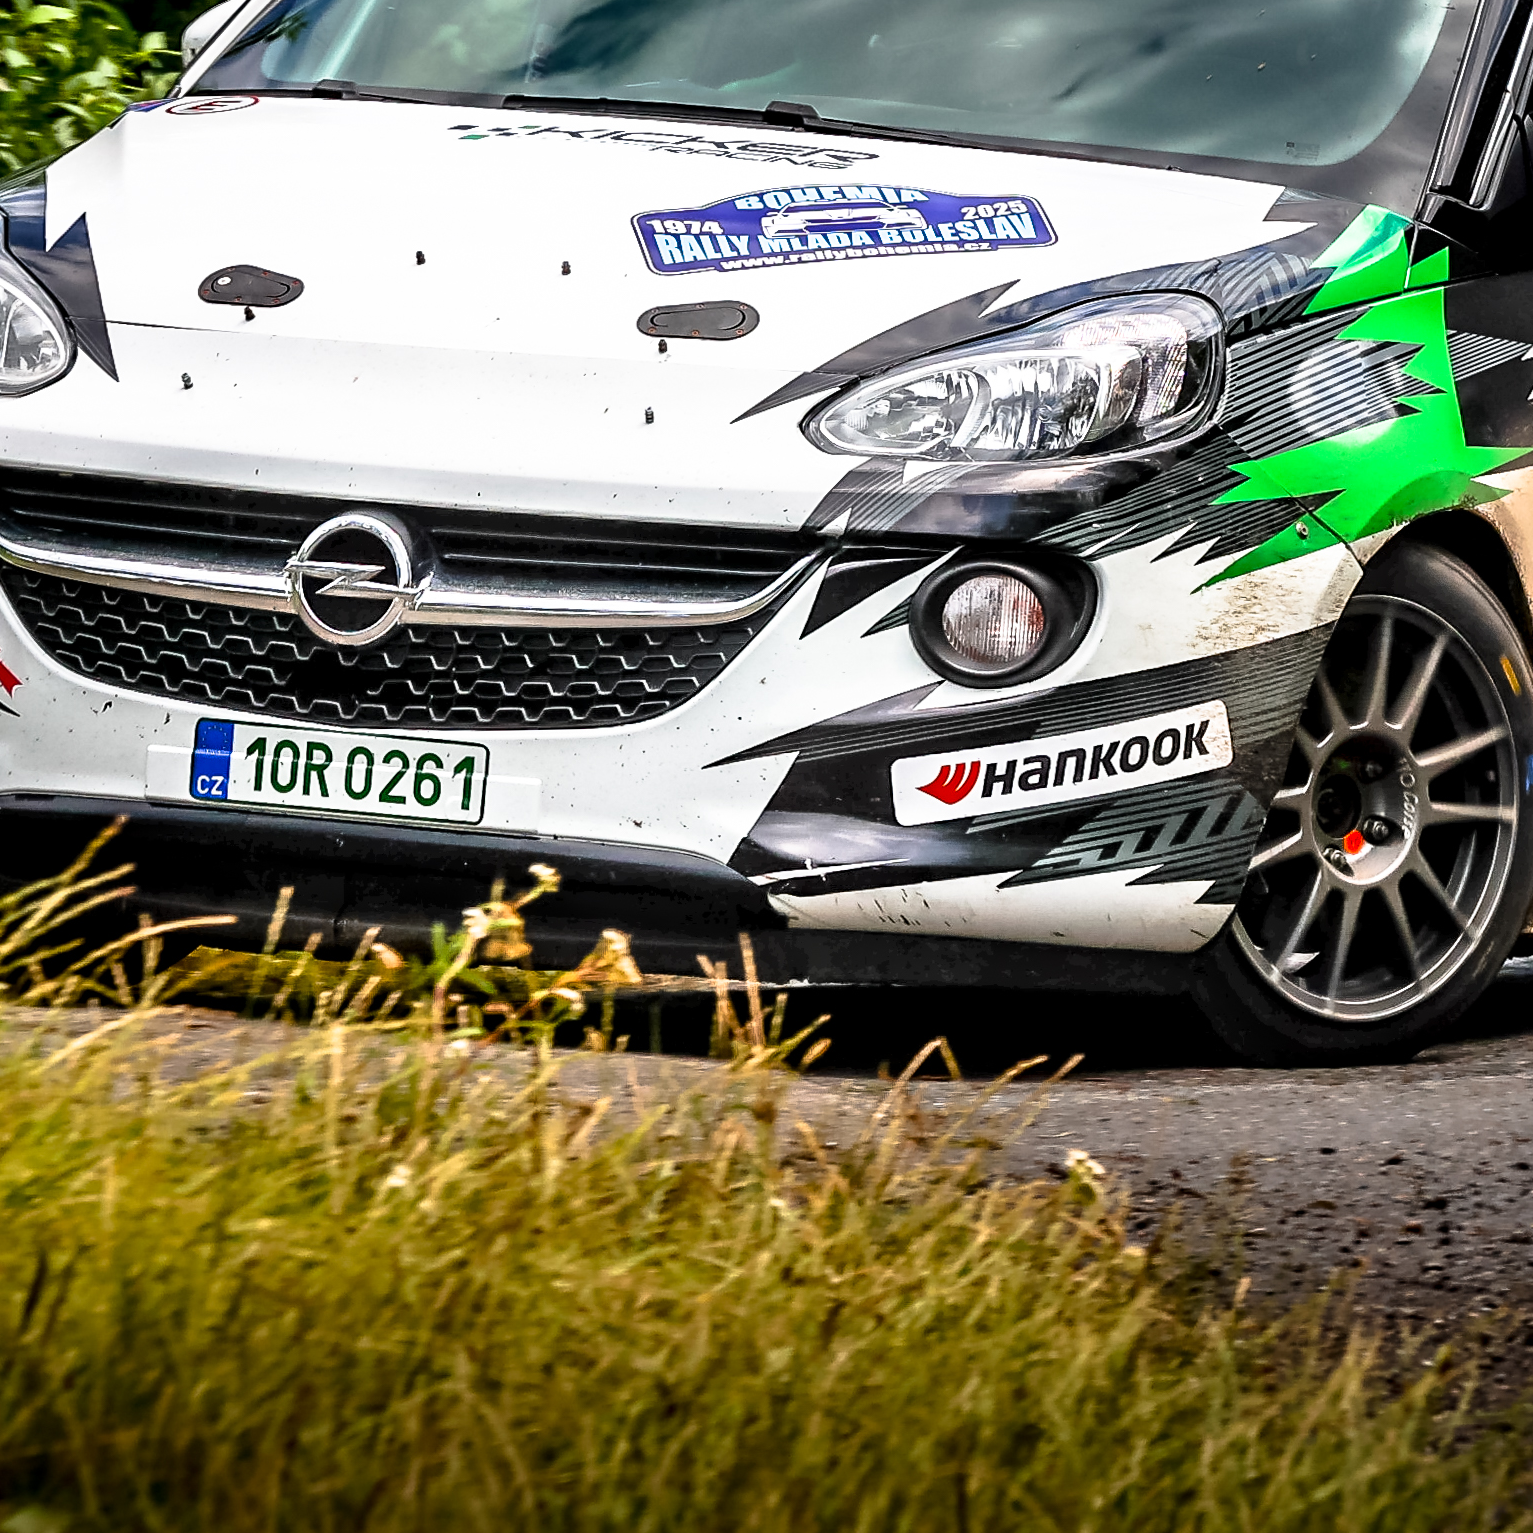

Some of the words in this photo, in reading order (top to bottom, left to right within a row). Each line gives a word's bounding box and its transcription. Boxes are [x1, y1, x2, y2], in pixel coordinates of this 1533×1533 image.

[525, 126, 880, 163] KICKER
[649, 145, 854, 169] RACING
[733, 185, 930, 210] BOHEMIA
[961, 199, 1029, 220] 2025
[646, 219, 724, 235] 1974
[654, 233, 751, 265] RALLY
[878, 212, 1037, 246] BOLESLAV
[720, 242, 992, 270] www.rallybohemia.cz
[196, 774, 225, 796] CZ
[244, 736, 334, 798] 10R
[344, 745, 476, 811] 0261
